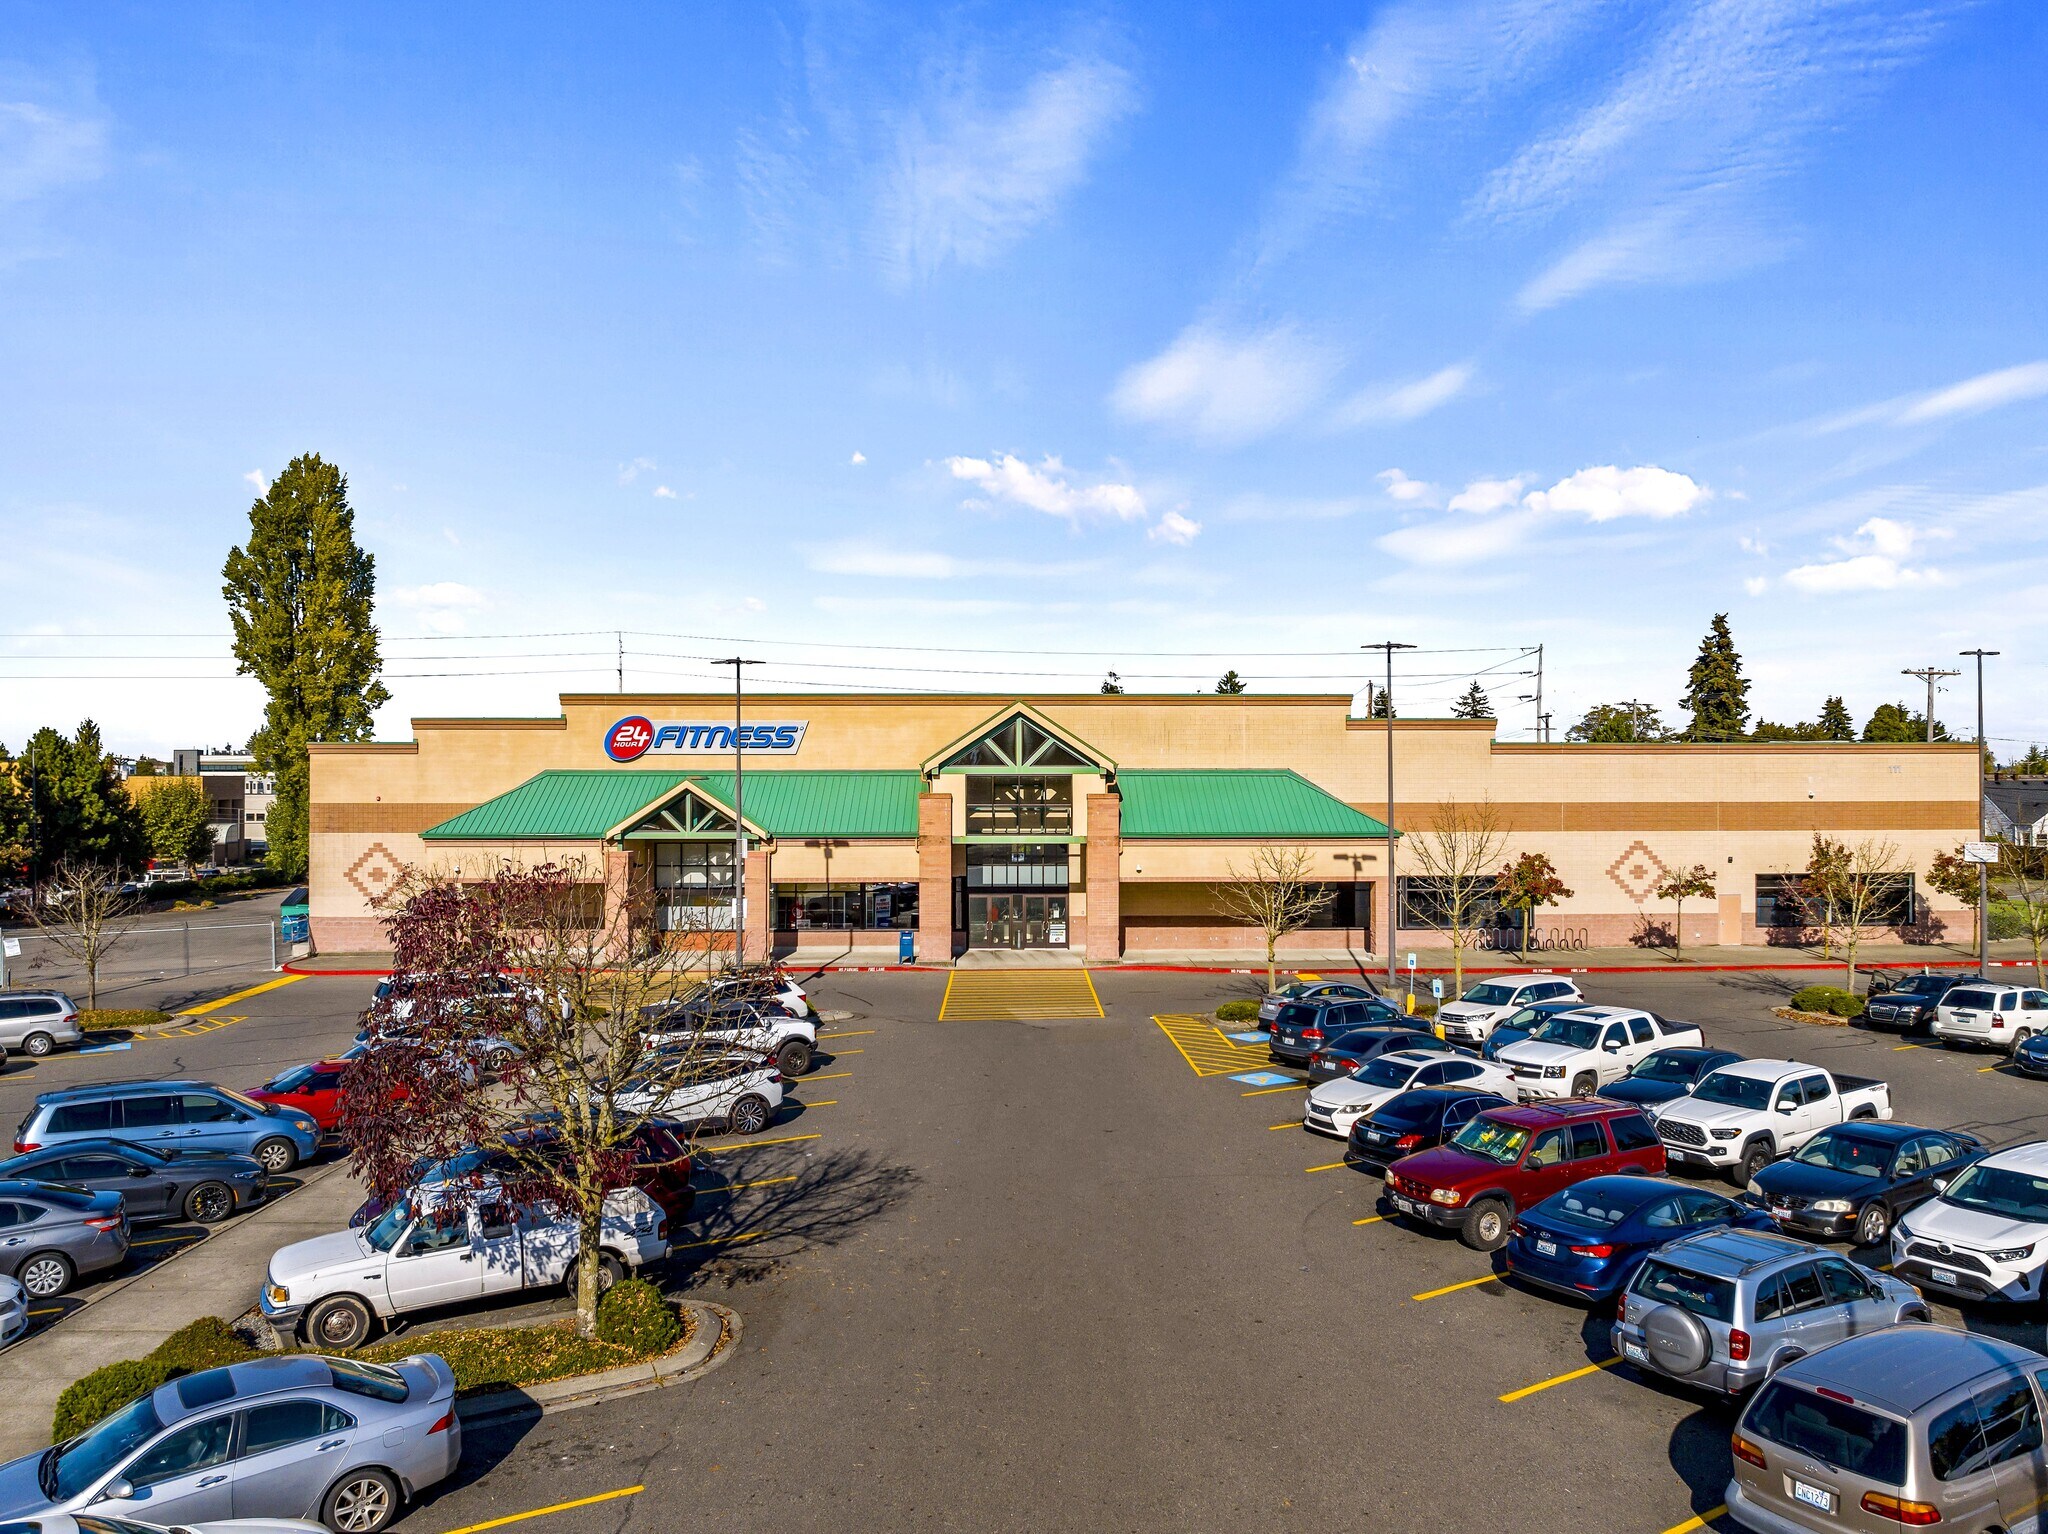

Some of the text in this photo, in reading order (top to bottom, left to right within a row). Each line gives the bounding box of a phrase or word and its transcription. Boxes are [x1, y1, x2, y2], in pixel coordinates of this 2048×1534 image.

[615, 725, 798, 749] 24 FITNESS
[1796, 1486, 1829, 1508] CNC1273
